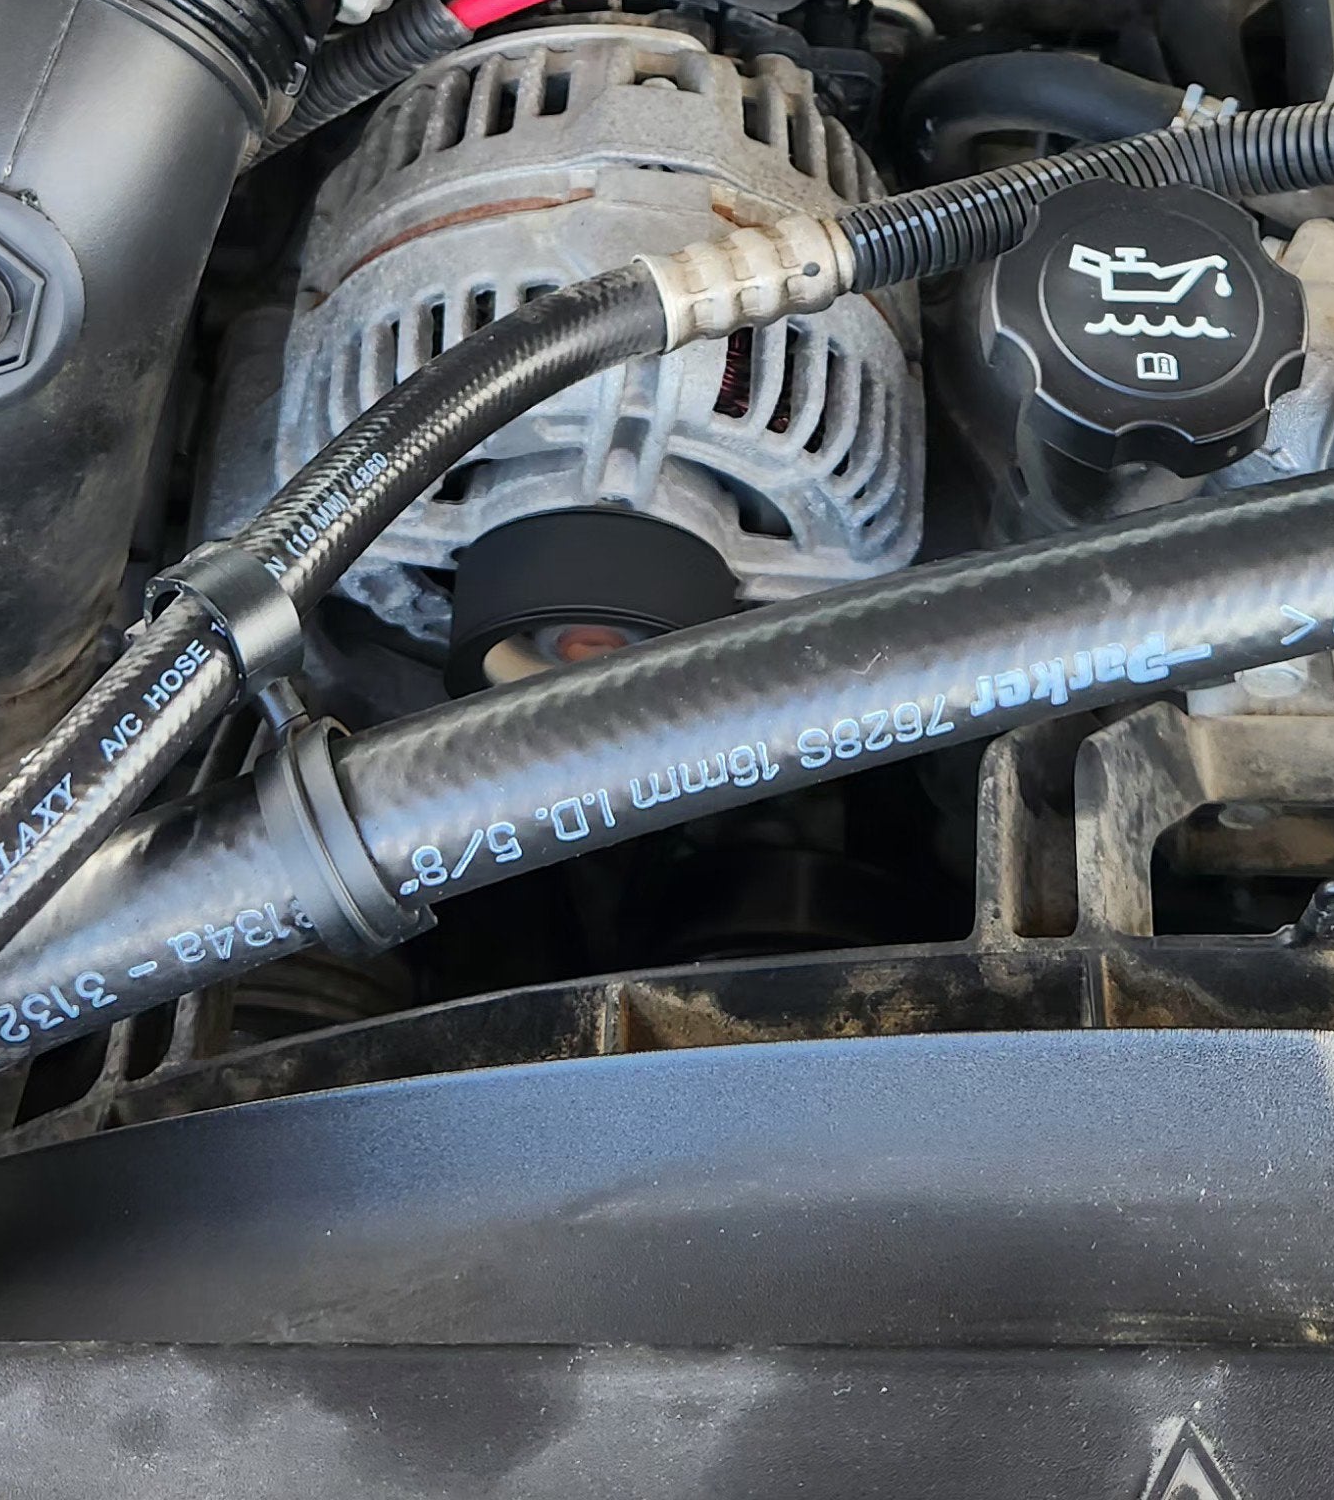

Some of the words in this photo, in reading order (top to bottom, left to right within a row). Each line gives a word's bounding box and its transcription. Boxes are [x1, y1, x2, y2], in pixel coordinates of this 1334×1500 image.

[99, 712, 143, 762] A/C
[142, 639, 211, 710] HOSE
[349, 451, 388, 491] 4860
[970, 633, 1173, 717] Parker
[797, 694, 955, 770] 7628S
[630, 741, 779, 809] 16mm
